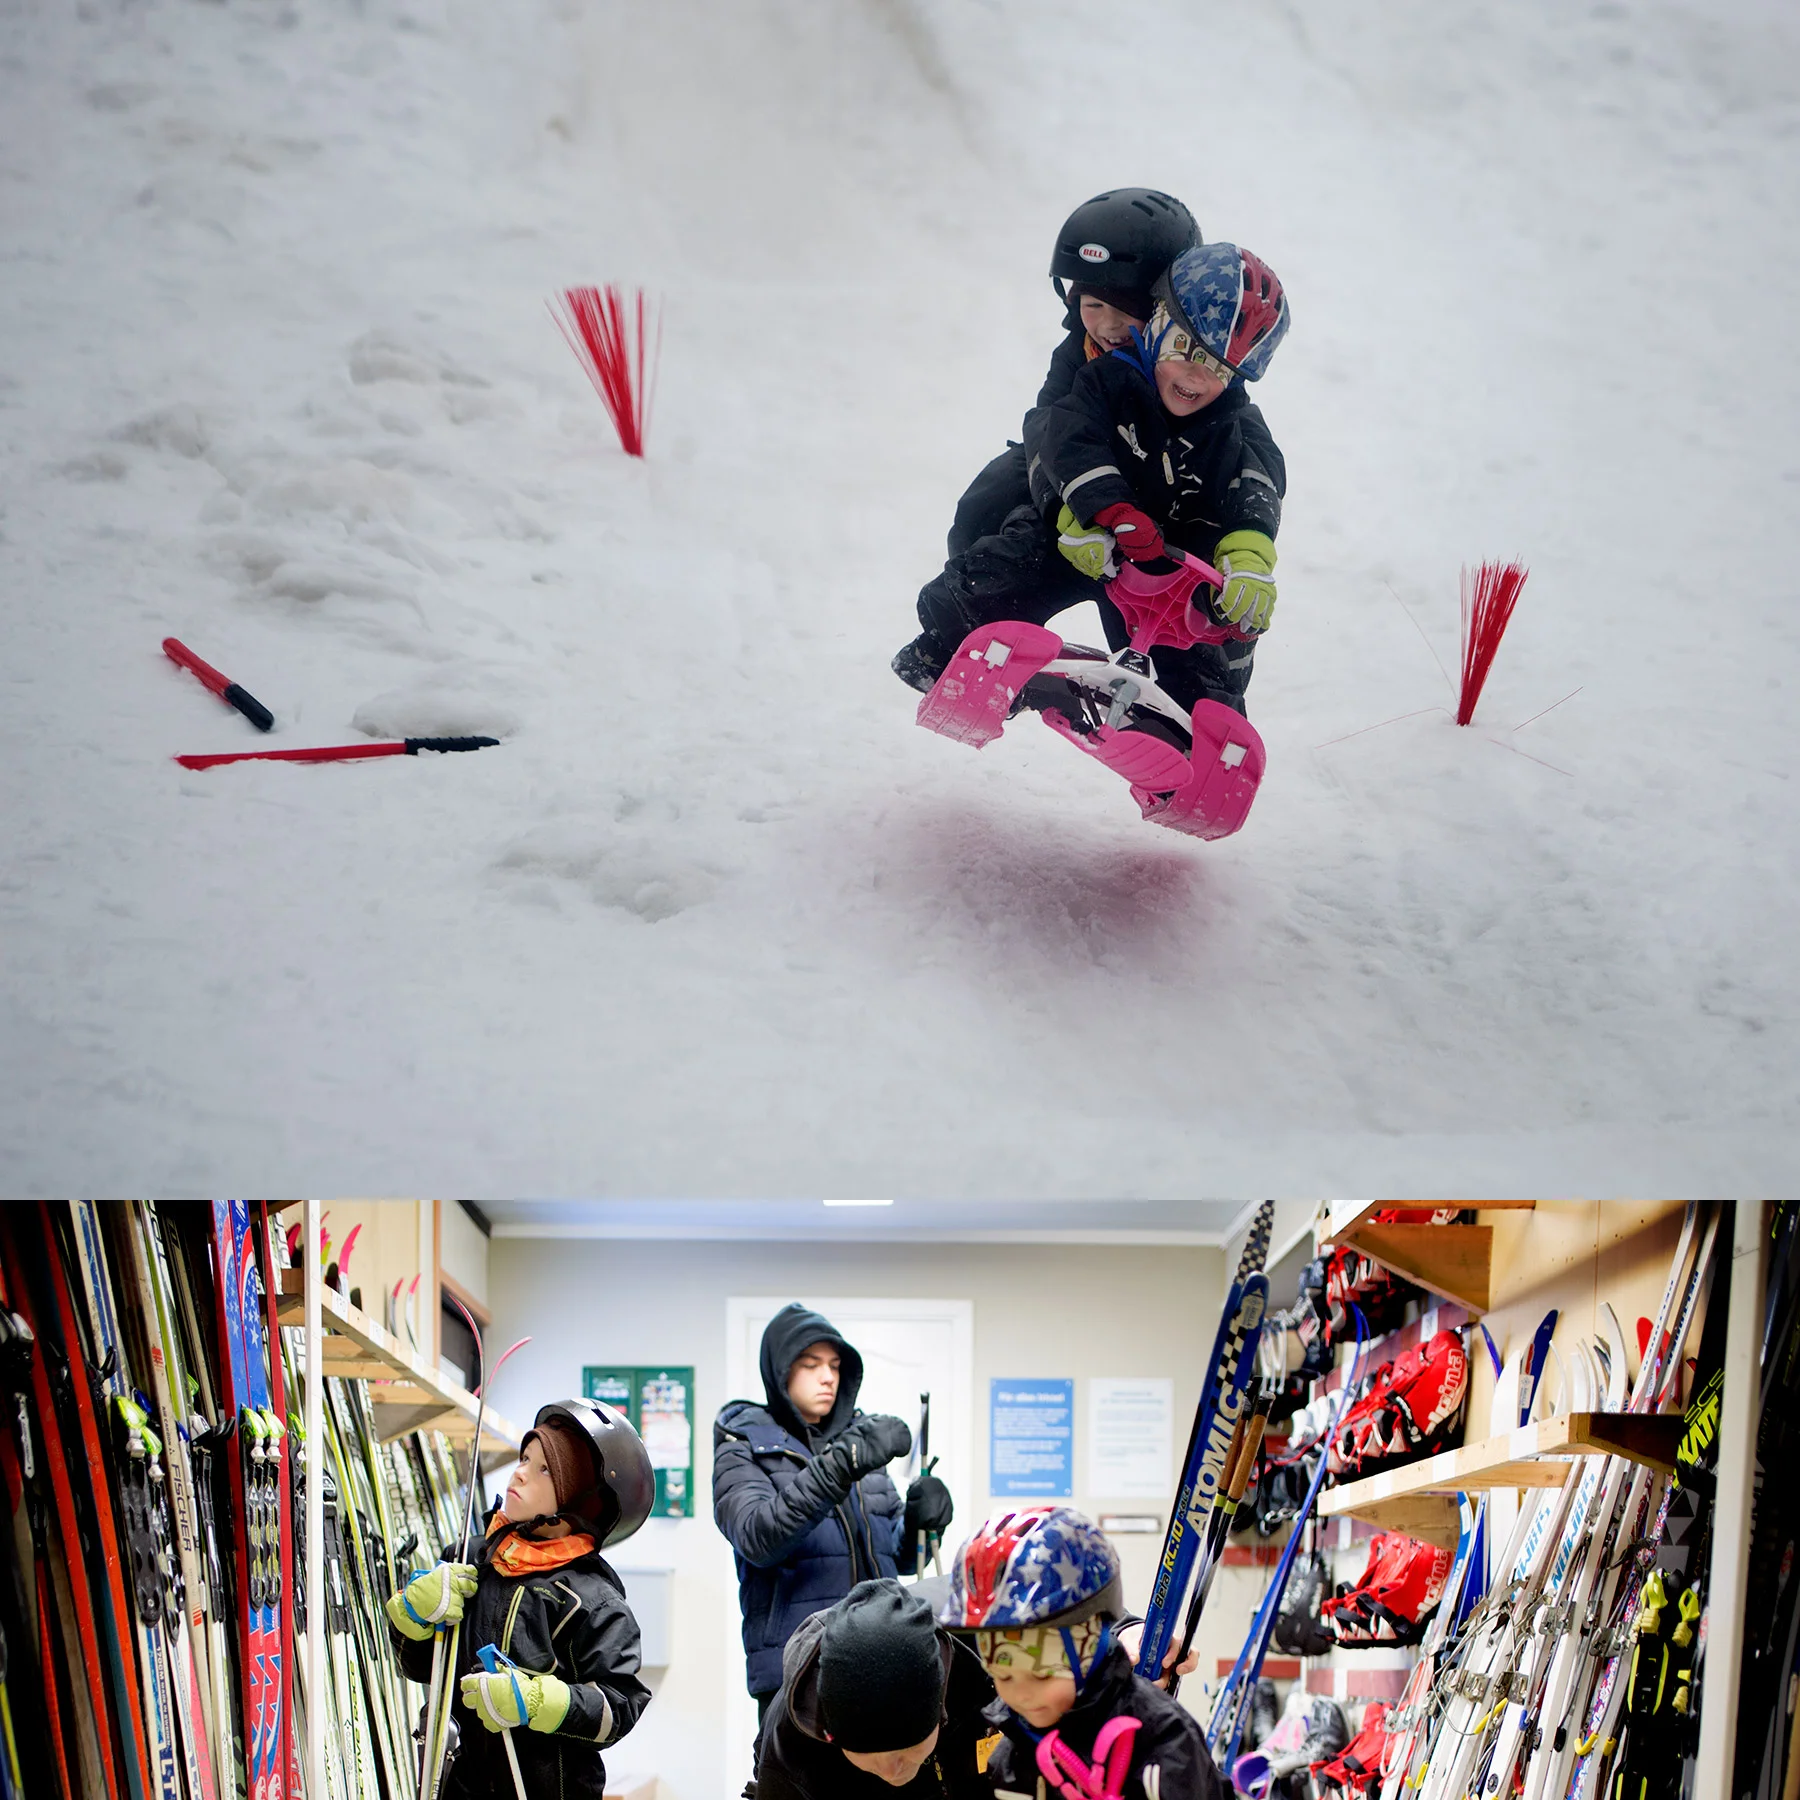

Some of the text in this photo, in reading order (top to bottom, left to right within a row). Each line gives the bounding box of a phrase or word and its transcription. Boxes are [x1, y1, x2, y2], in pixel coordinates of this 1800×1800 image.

[1083, 248, 1104, 259] BELL
[1185, 1383, 1245, 1539] ATOMIC
[171, 1463, 192, 1552] FISCHER
[1154, 1573, 1171, 1610] Beta
[160, 1757, 177, 1796] LT
